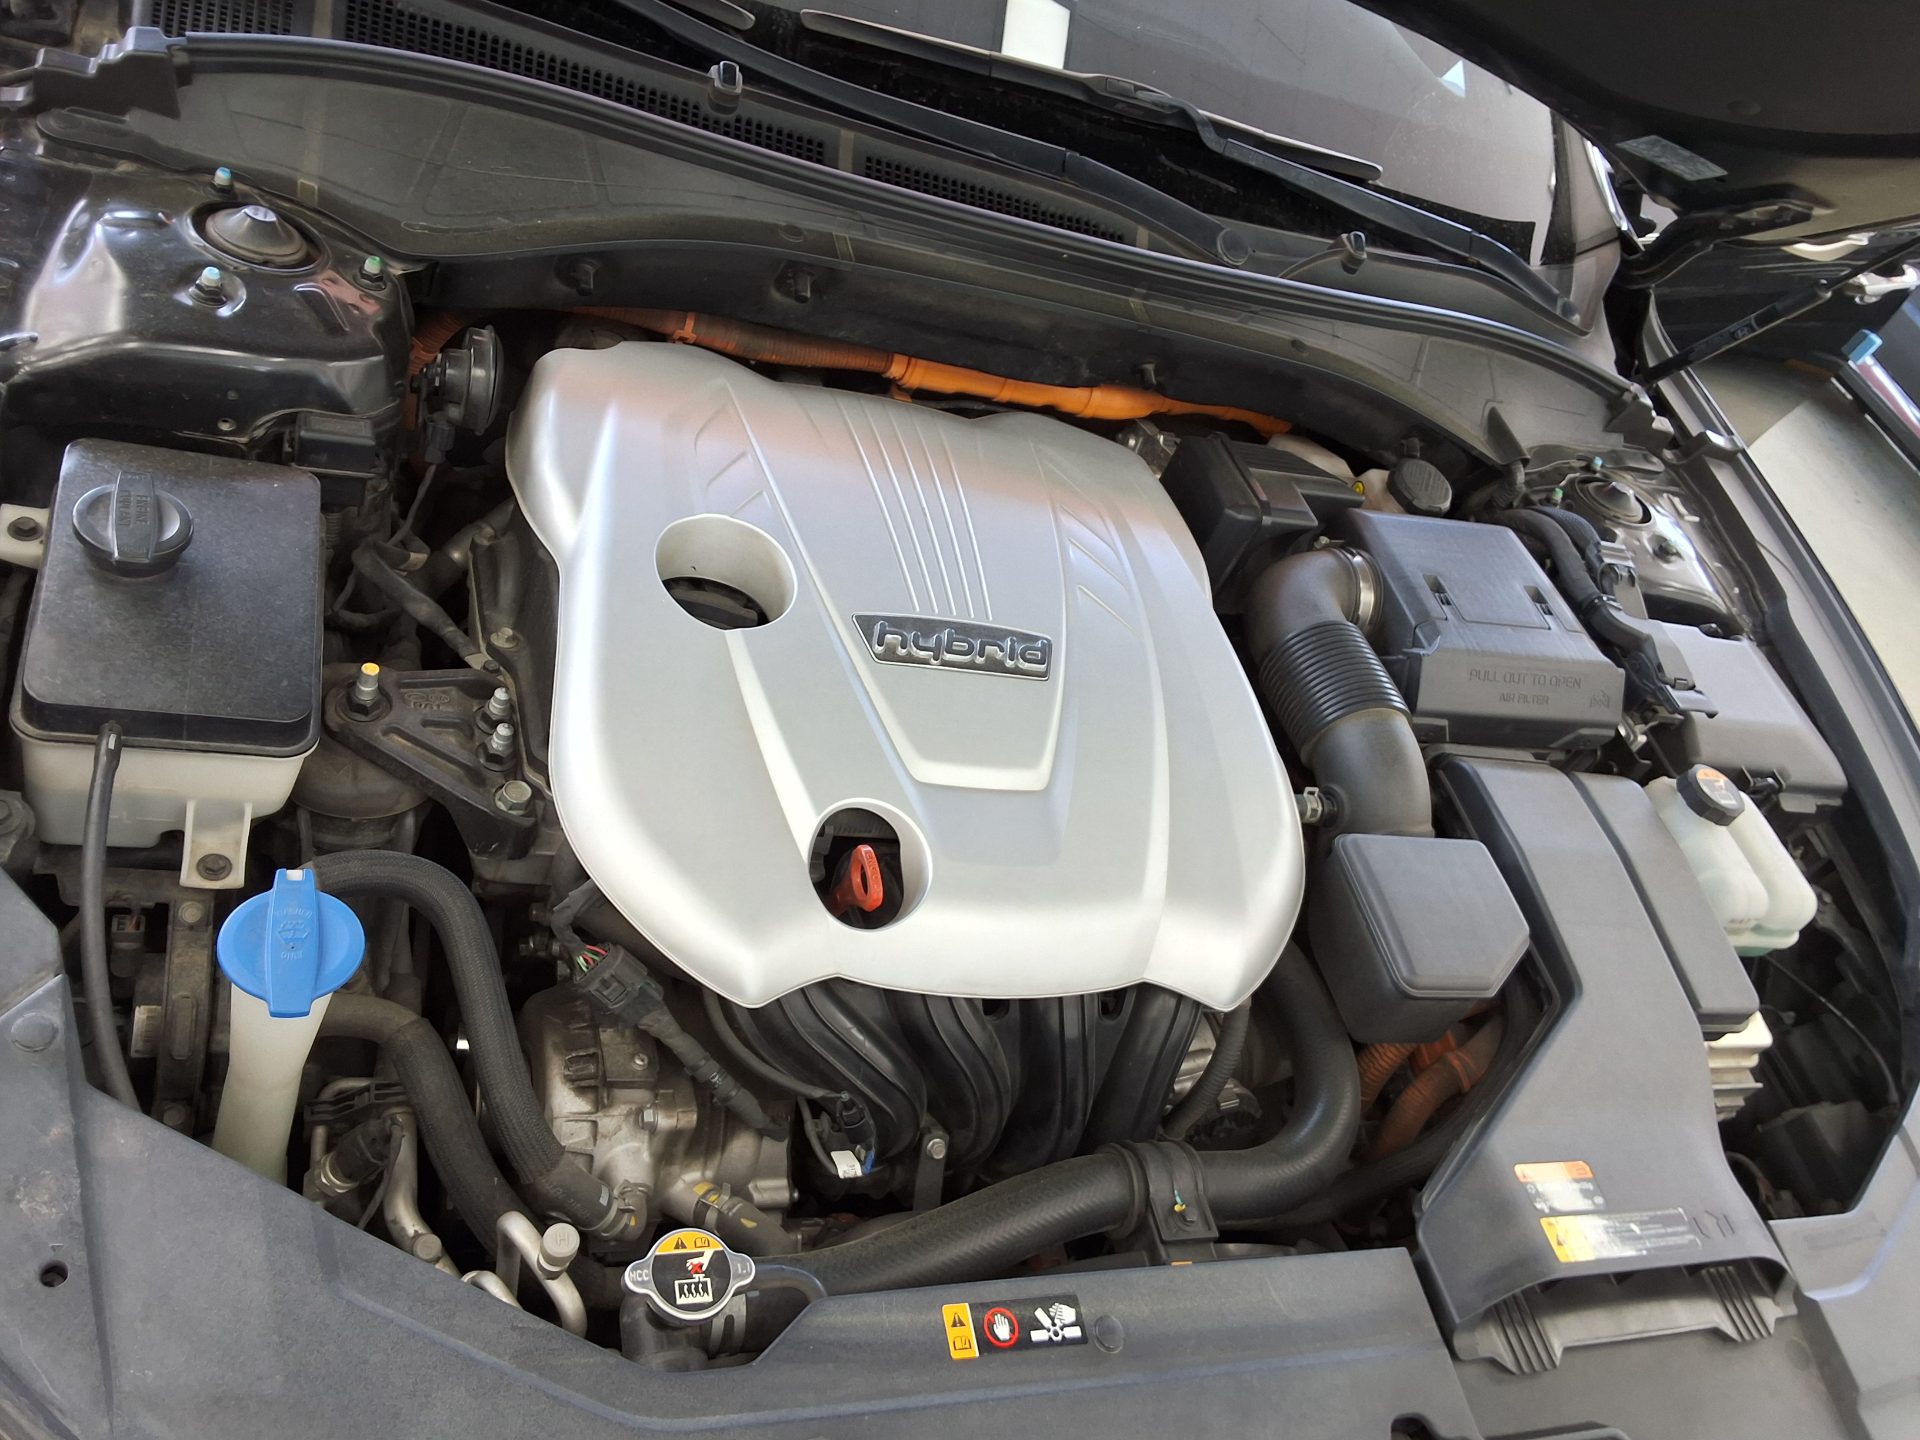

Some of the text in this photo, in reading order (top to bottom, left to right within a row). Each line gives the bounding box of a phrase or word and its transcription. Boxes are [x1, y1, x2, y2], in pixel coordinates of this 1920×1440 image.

[874, 620, 1048, 672] hybrid
[1469, 668, 1582, 689] PULL OUT TO OPEN
[1499, 691, 1550, 705] AIR FILTER
